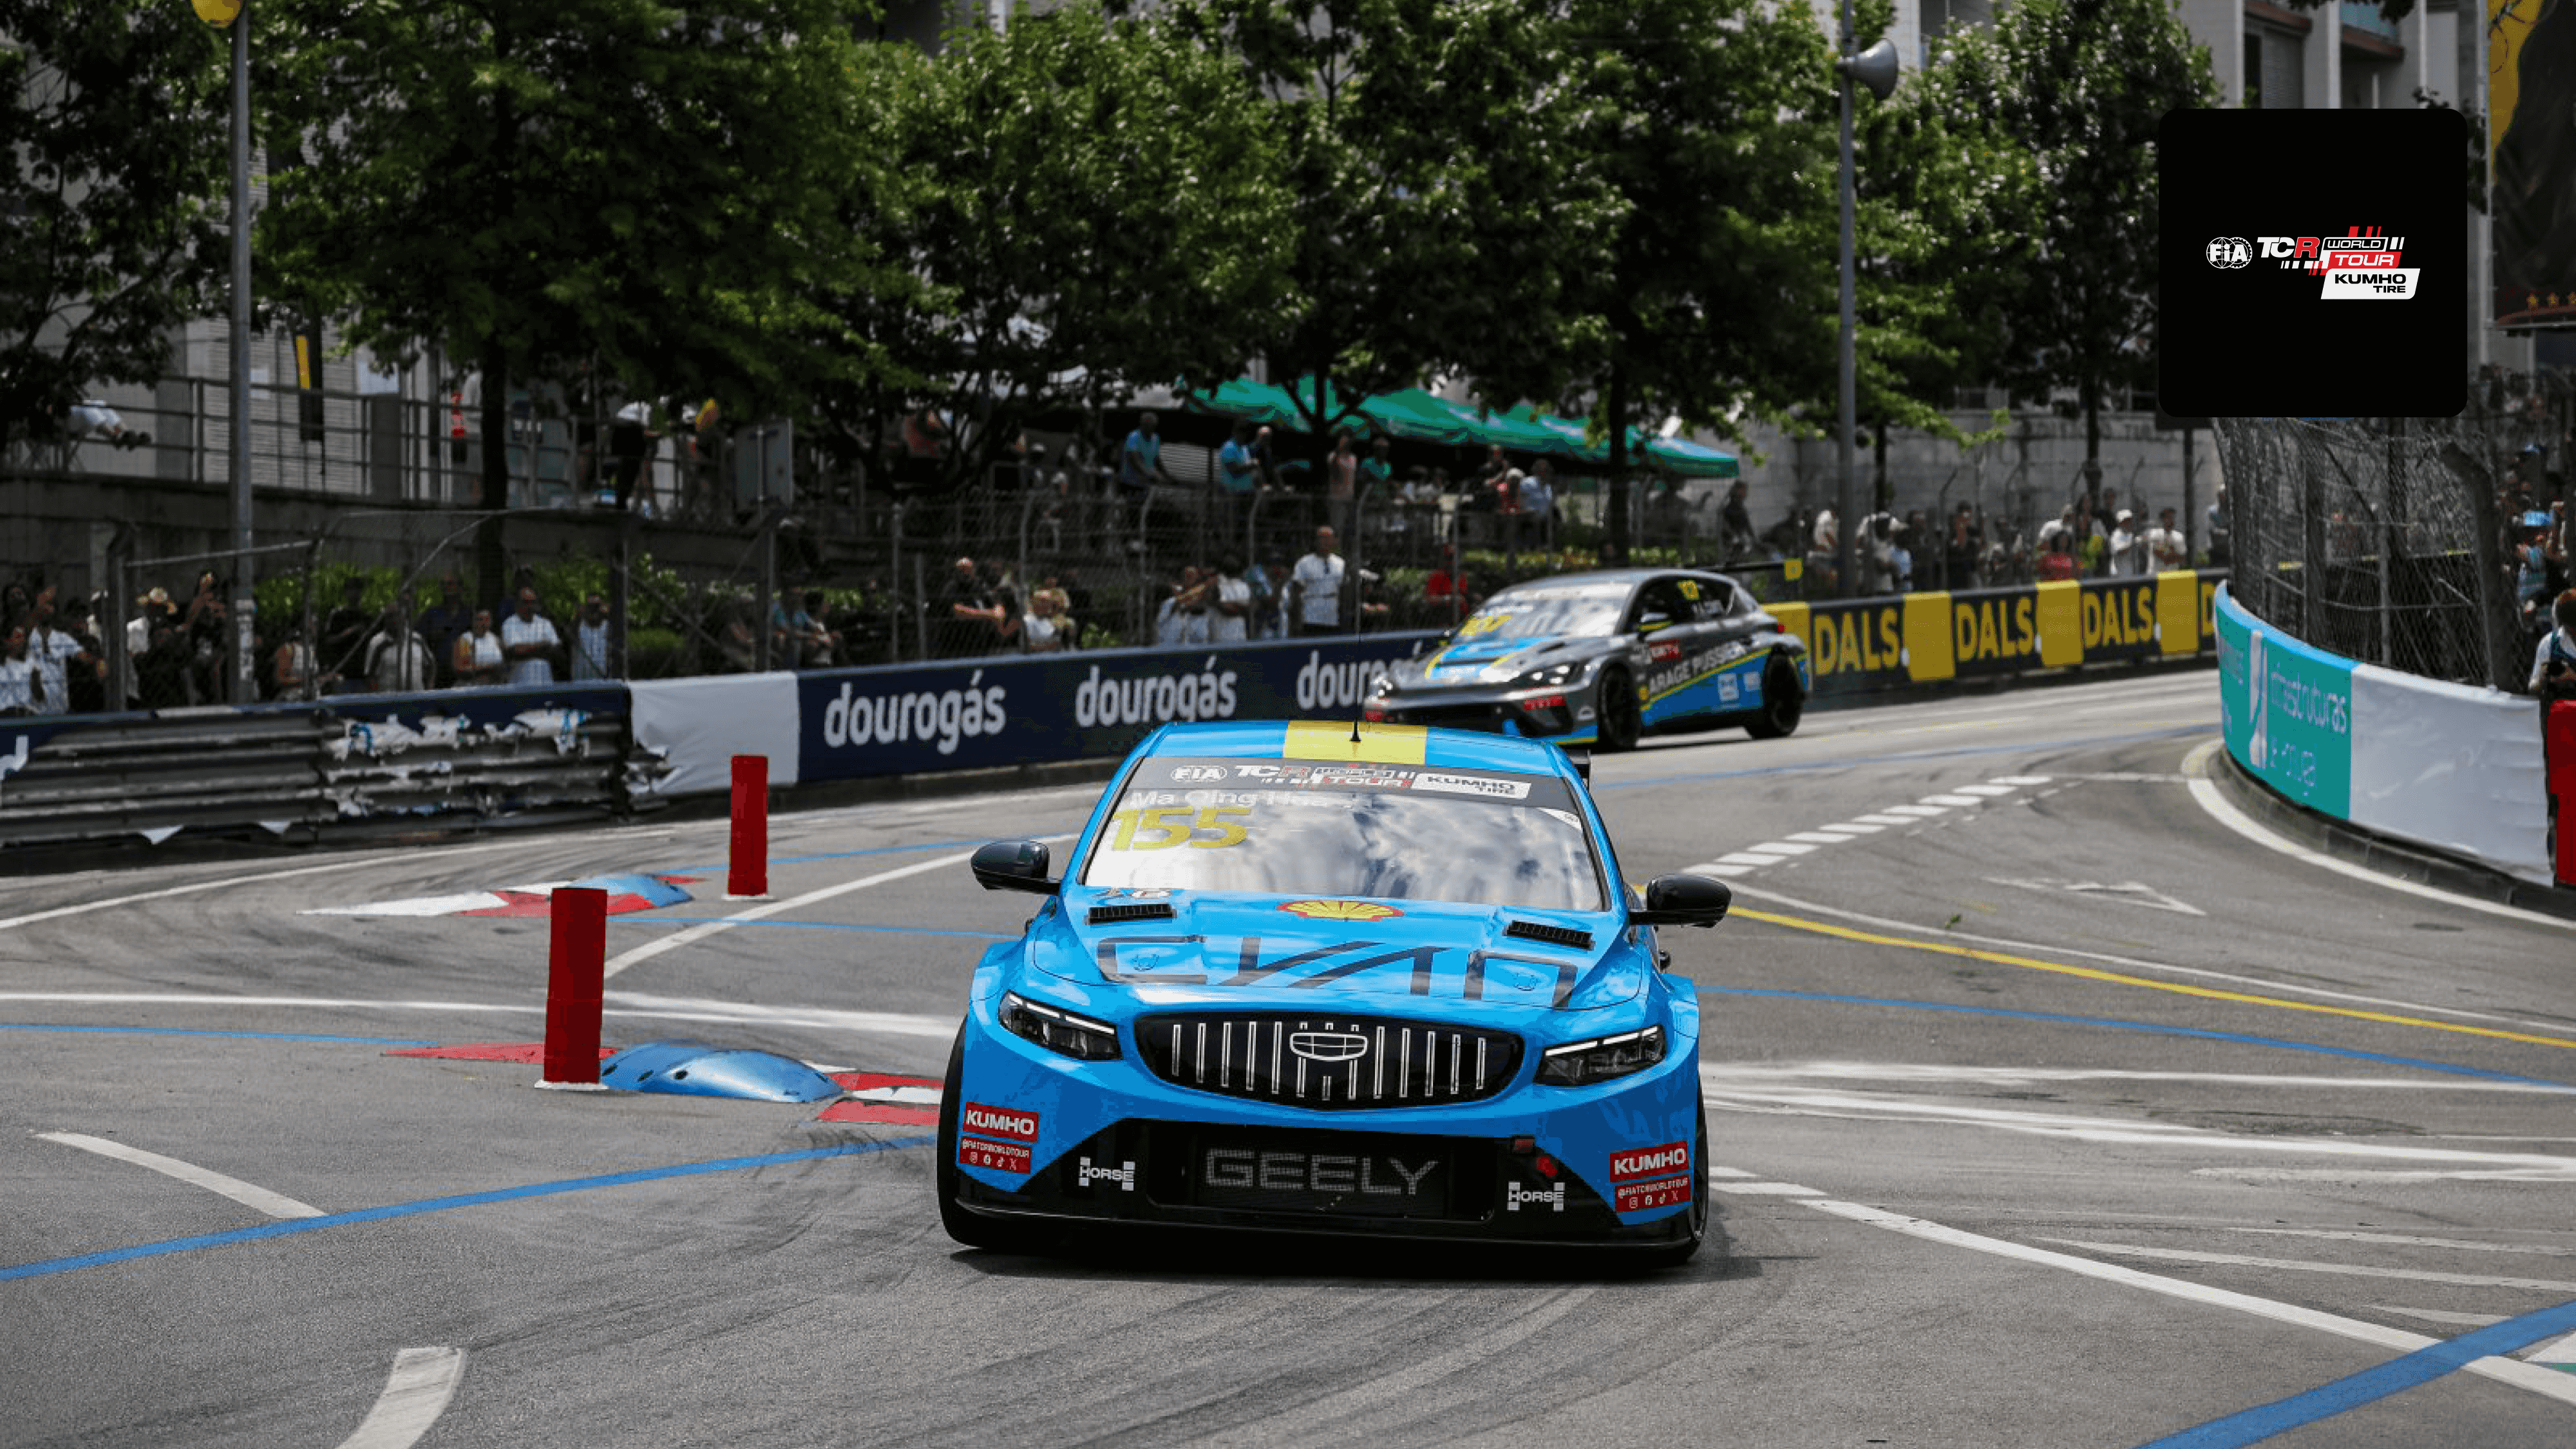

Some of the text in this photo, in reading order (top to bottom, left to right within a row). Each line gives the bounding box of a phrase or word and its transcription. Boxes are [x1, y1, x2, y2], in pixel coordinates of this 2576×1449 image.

[1075, 656, 1237, 727] dourogás
[824, 668, 1007, 755] dourogás
[1426, 776, 1515, 790] KUMHO
[1112, 806, 1251, 851] 155
[967, 1110, 1034, 1135] KUMHO
[1079, 1164, 1135, 1184] HORSE
[1206, 1148, 1438, 1195] GEELY
[1615, 1148, 1686, 1175] KUMHO
[1507, 1189, 1565, 1204] HORSE
